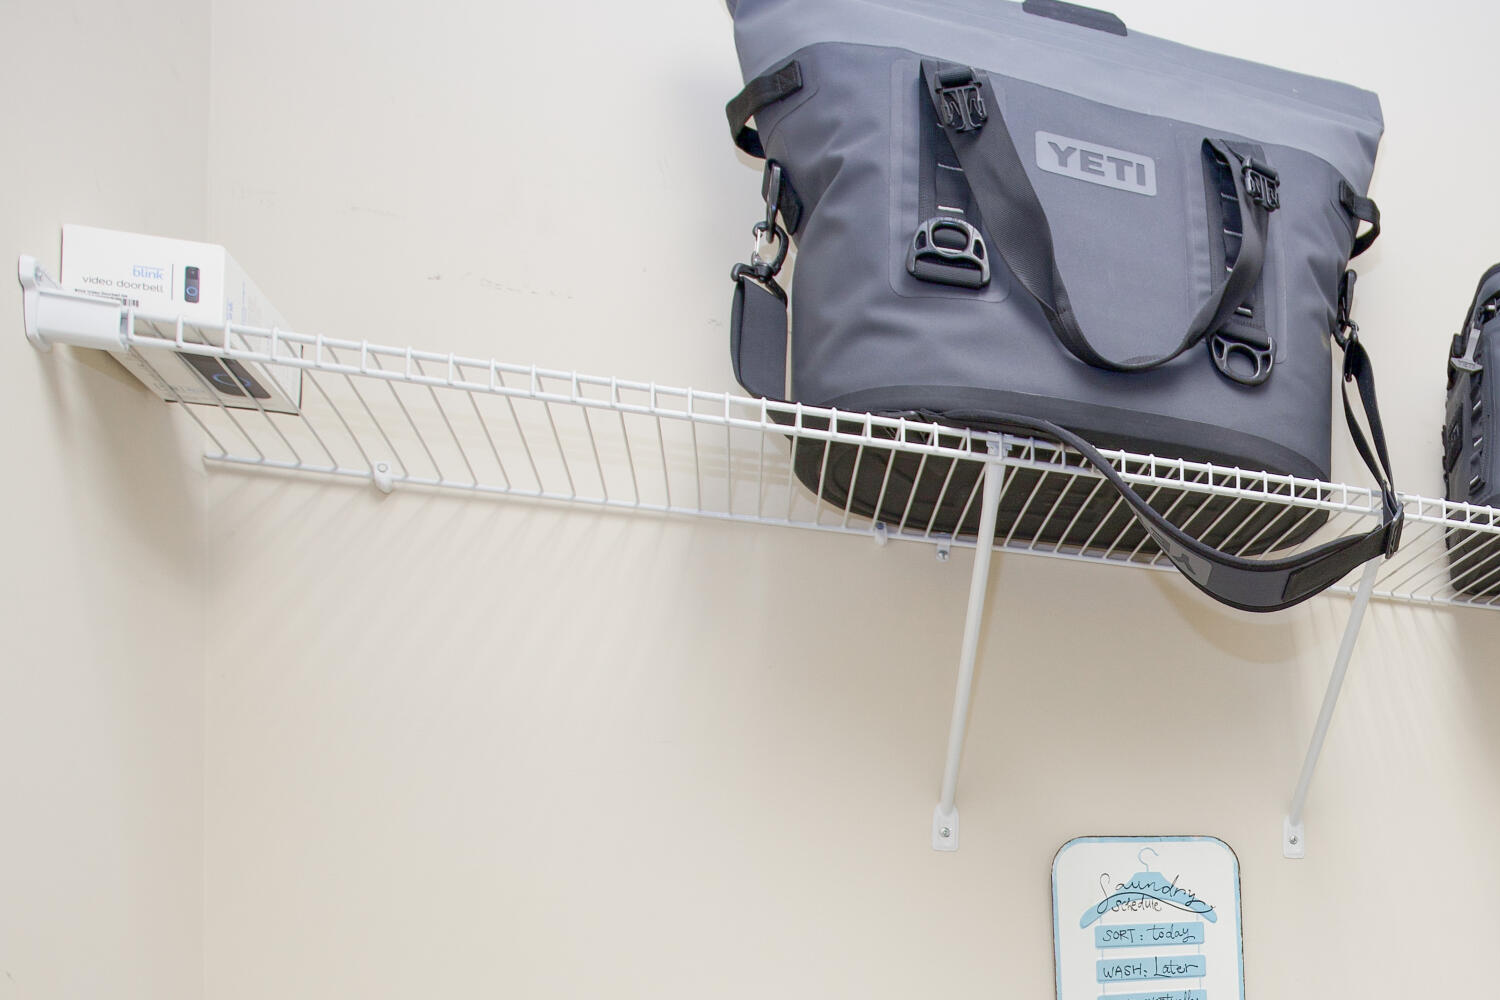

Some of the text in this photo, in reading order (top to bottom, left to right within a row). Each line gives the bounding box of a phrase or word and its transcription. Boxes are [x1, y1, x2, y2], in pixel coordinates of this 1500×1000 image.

[1047, 141, 1147, 187] YETI
[133, 266, 164, 280] blink
[82, 275, 113, 287] video
[116, 279, 164, 294] doorbell
[1097, 872, 1216, 914] Laundry
[1146, 923, 1196, 943] today
[1153, 955, 1199, 978] Later
